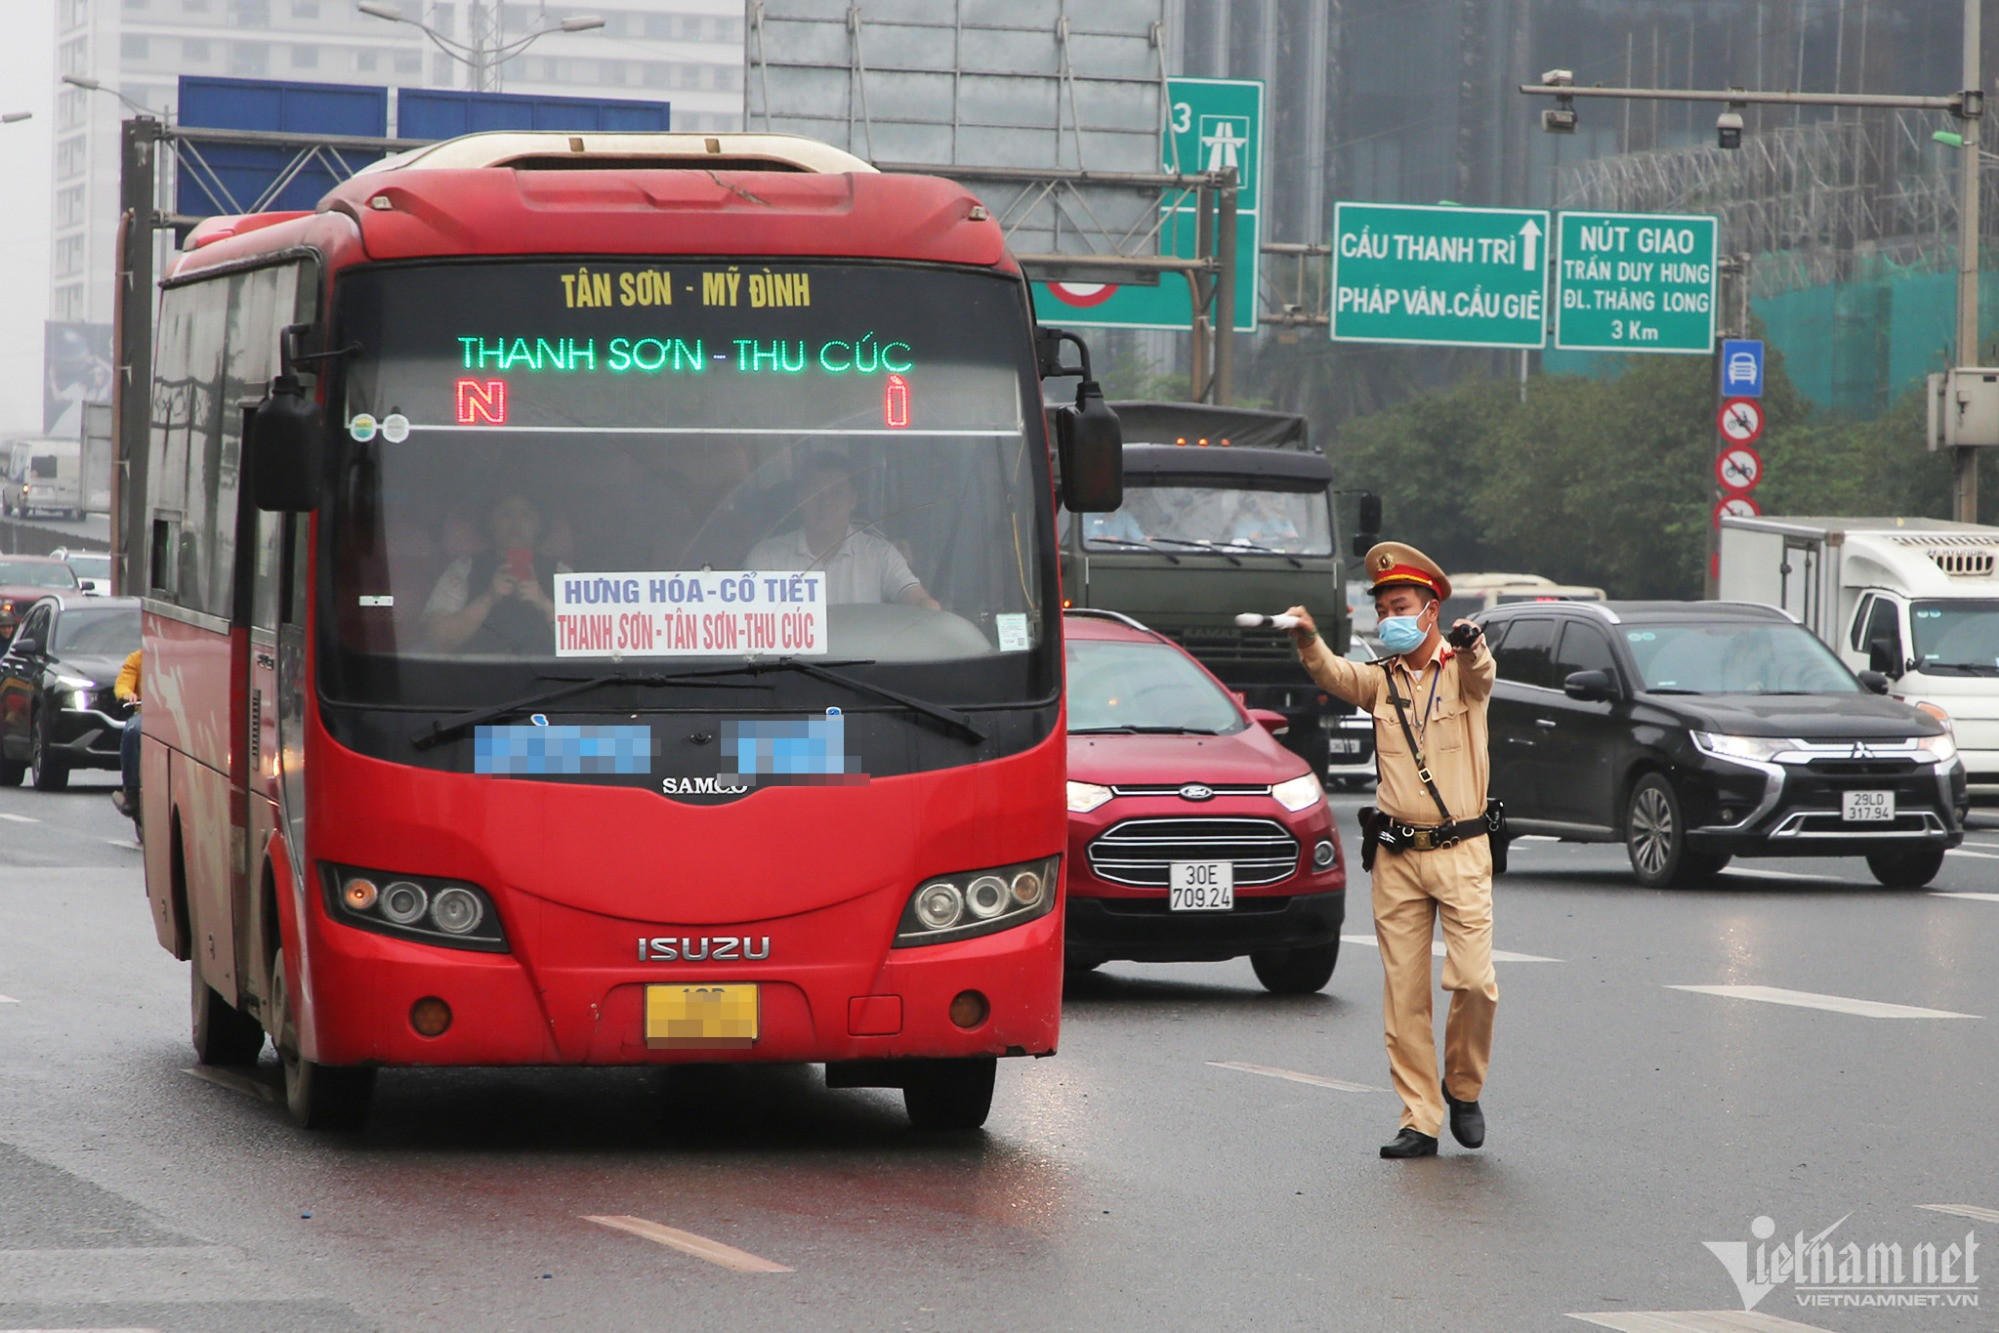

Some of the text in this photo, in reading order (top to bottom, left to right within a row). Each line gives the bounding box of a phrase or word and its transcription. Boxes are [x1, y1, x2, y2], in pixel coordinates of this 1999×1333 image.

[1393, 234, 1474, 263] THANH
[1477, 235, 1516, 264] TRÌ
[1580, 220, 1694, 254] NÚT GIAO
[1617, 261, 1654, 282] DUY
[1660, 262, 1710, 284] HƯNG
[561, 267, 612, 308] TÂN
[619, 269, 672, 307] SƠN
[702, 266, 741, 307] MỸ
[748, 267, 811, 308] ĐÌNH
[1338, 284, 1400, 314] PHÁP
[1663, 292, 1710, 312] LONG
[1611, 320, 1659, 340] 3 Km
[457, 337, 595, 371] THANH
[608, 337, 703, 371] SƠN
[733, 339, 805, 372] THU
[819, 330, 912, 373] CÚC
[564, 577, 640, 604] HƯNG
[764, 573, 819, 603] TIẾT
[557, 614, 613, 650] THANH
[781, 597, 815, 649] CÚC
[1854, 793, 1884, 806] 29LD
[1849, 807, 1889, 820] 317.94
[1186, 865, 1218, 885] 30E
[1173, 887, 1231, 909] 709.24
[638, 937, 770, 961] ISUZU
